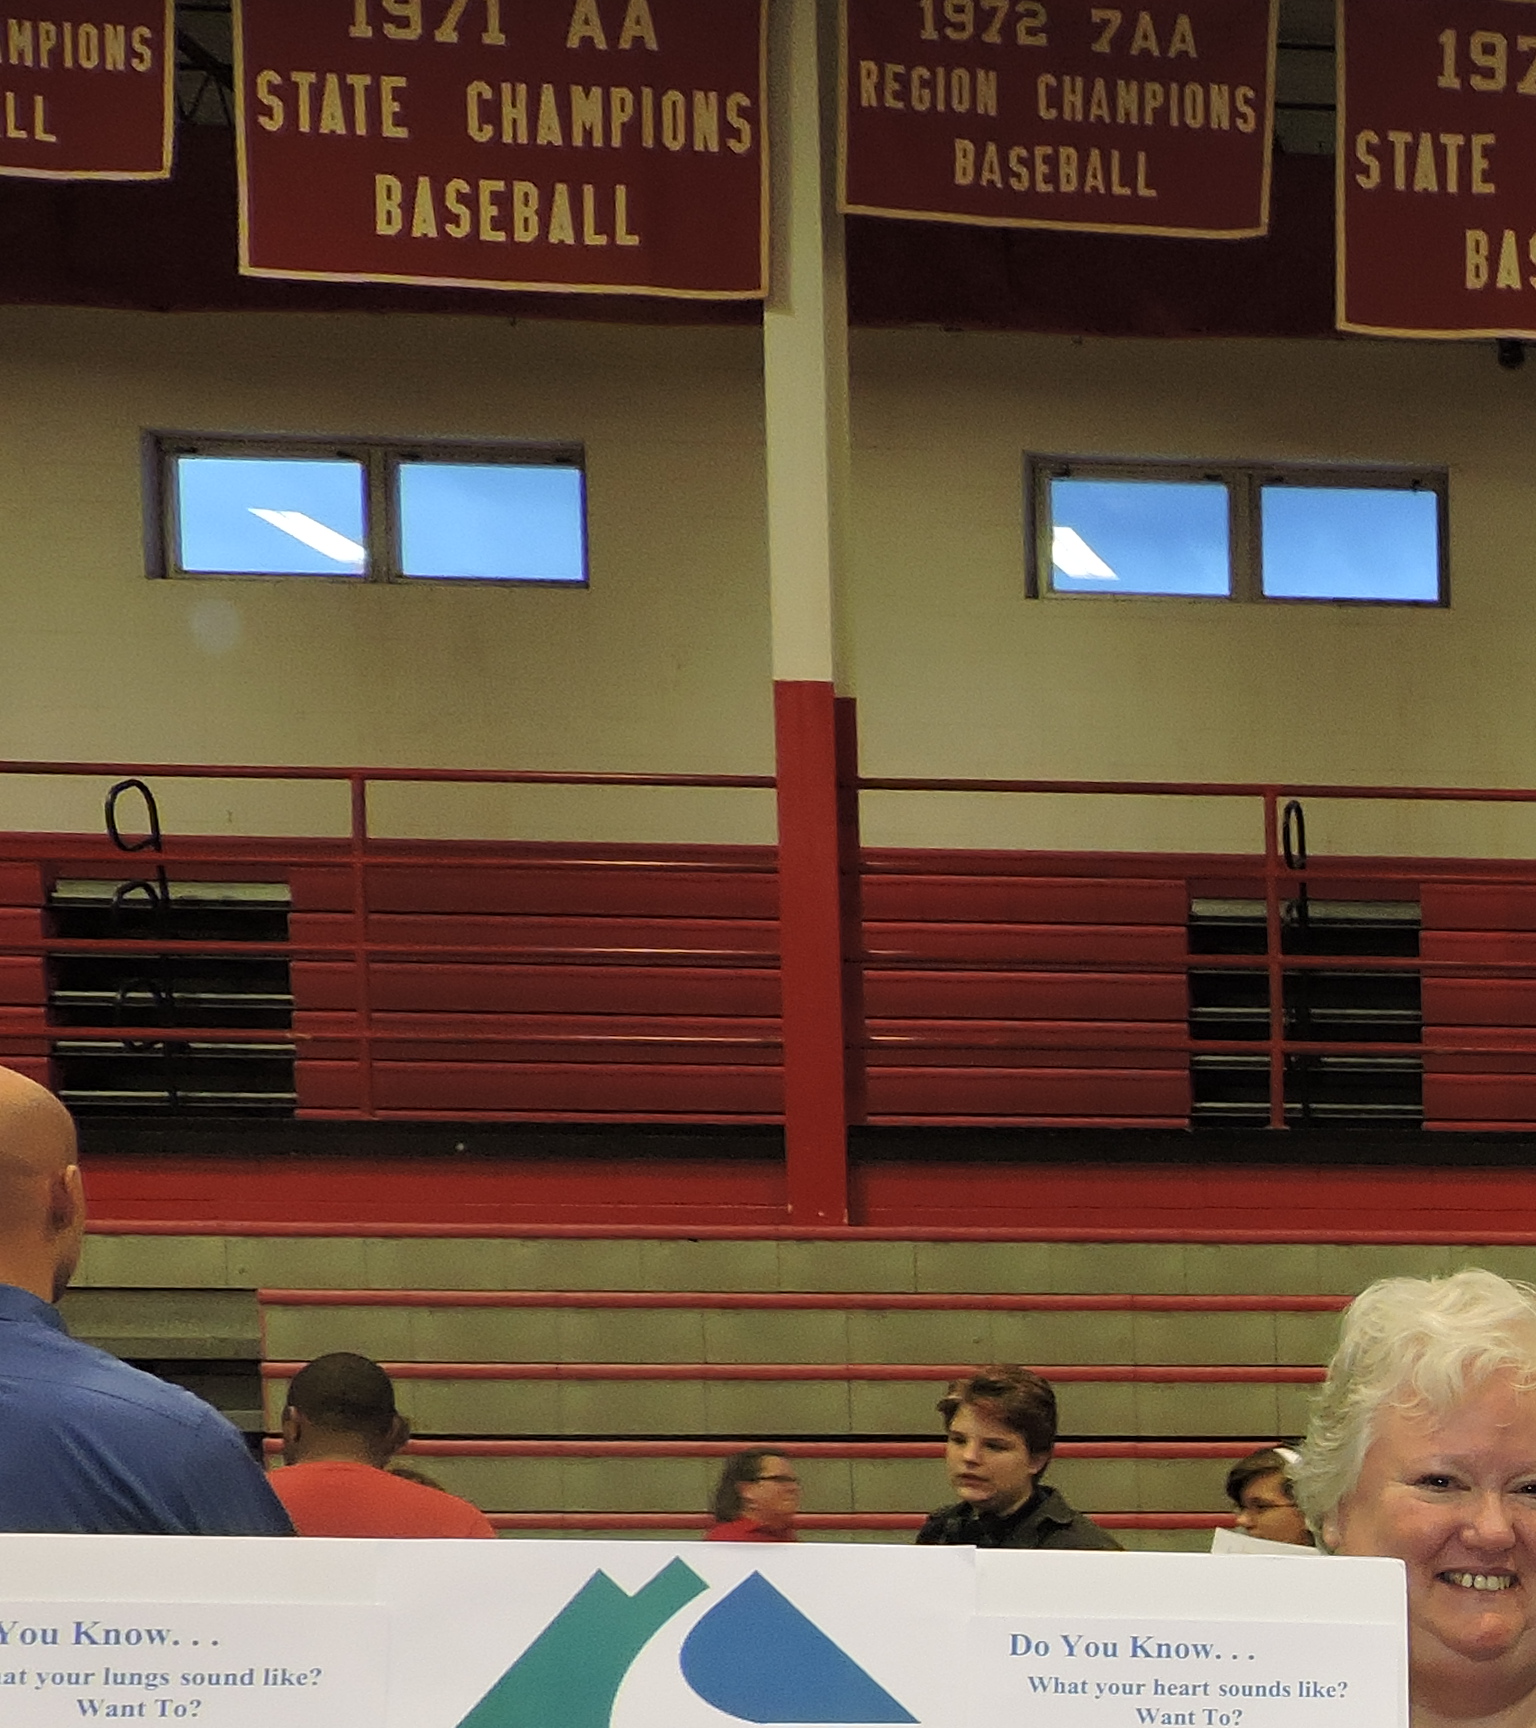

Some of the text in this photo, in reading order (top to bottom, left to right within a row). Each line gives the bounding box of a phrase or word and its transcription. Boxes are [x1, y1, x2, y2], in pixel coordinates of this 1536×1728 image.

[0, 19, 153, 71] MPIONS
[348, 0, 659, 51] 1971 AA
[918, 0, 1199, 60] 1972 7AA
[257, 70, 753, 155] STATE CHAMPIONS
[858, 60, 1257, 134] REGION CHAMPIONS
[953, 138, 1158, 199] BASEBALL
[1355, 129, 1497, 195] STATE
[374, 174, 642, 247] BASEBALL
[1008, 1633, 1119, 1658] Do You
[36, 1667, 322, 1692] your lungs sound like?
[1028, 1676, 1348, 1699] What your heart sounds like?
[76, 1699, 202, 1719] Want To?
[1136, 1707, 1243, 1727] Want To?
